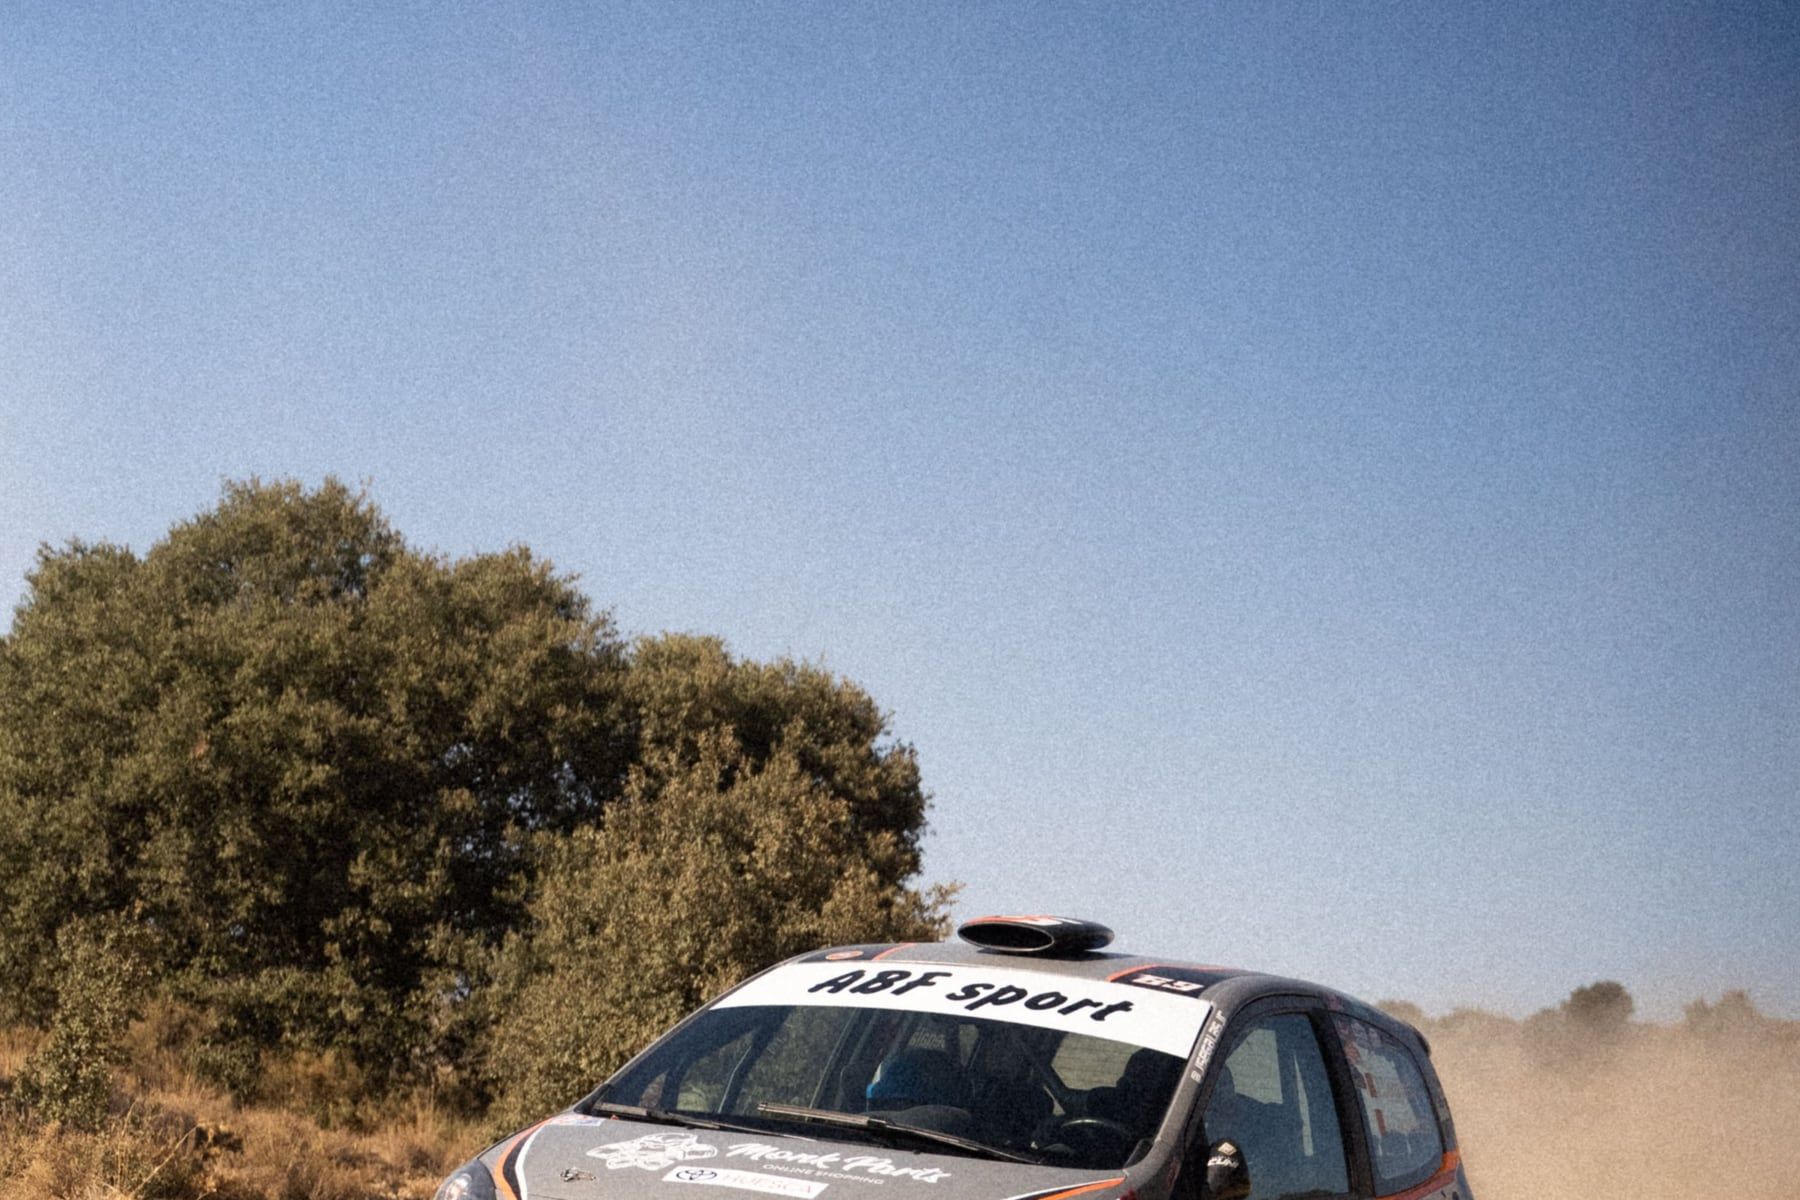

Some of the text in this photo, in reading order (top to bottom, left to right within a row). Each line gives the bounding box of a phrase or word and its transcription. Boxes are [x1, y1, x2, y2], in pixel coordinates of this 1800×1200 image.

[807, 969, 1134, 1022] ABF sport
[762, 1163, 885, 1186] ONLINE SHOPPING
[841, 1154, 953, 1184] Parts
